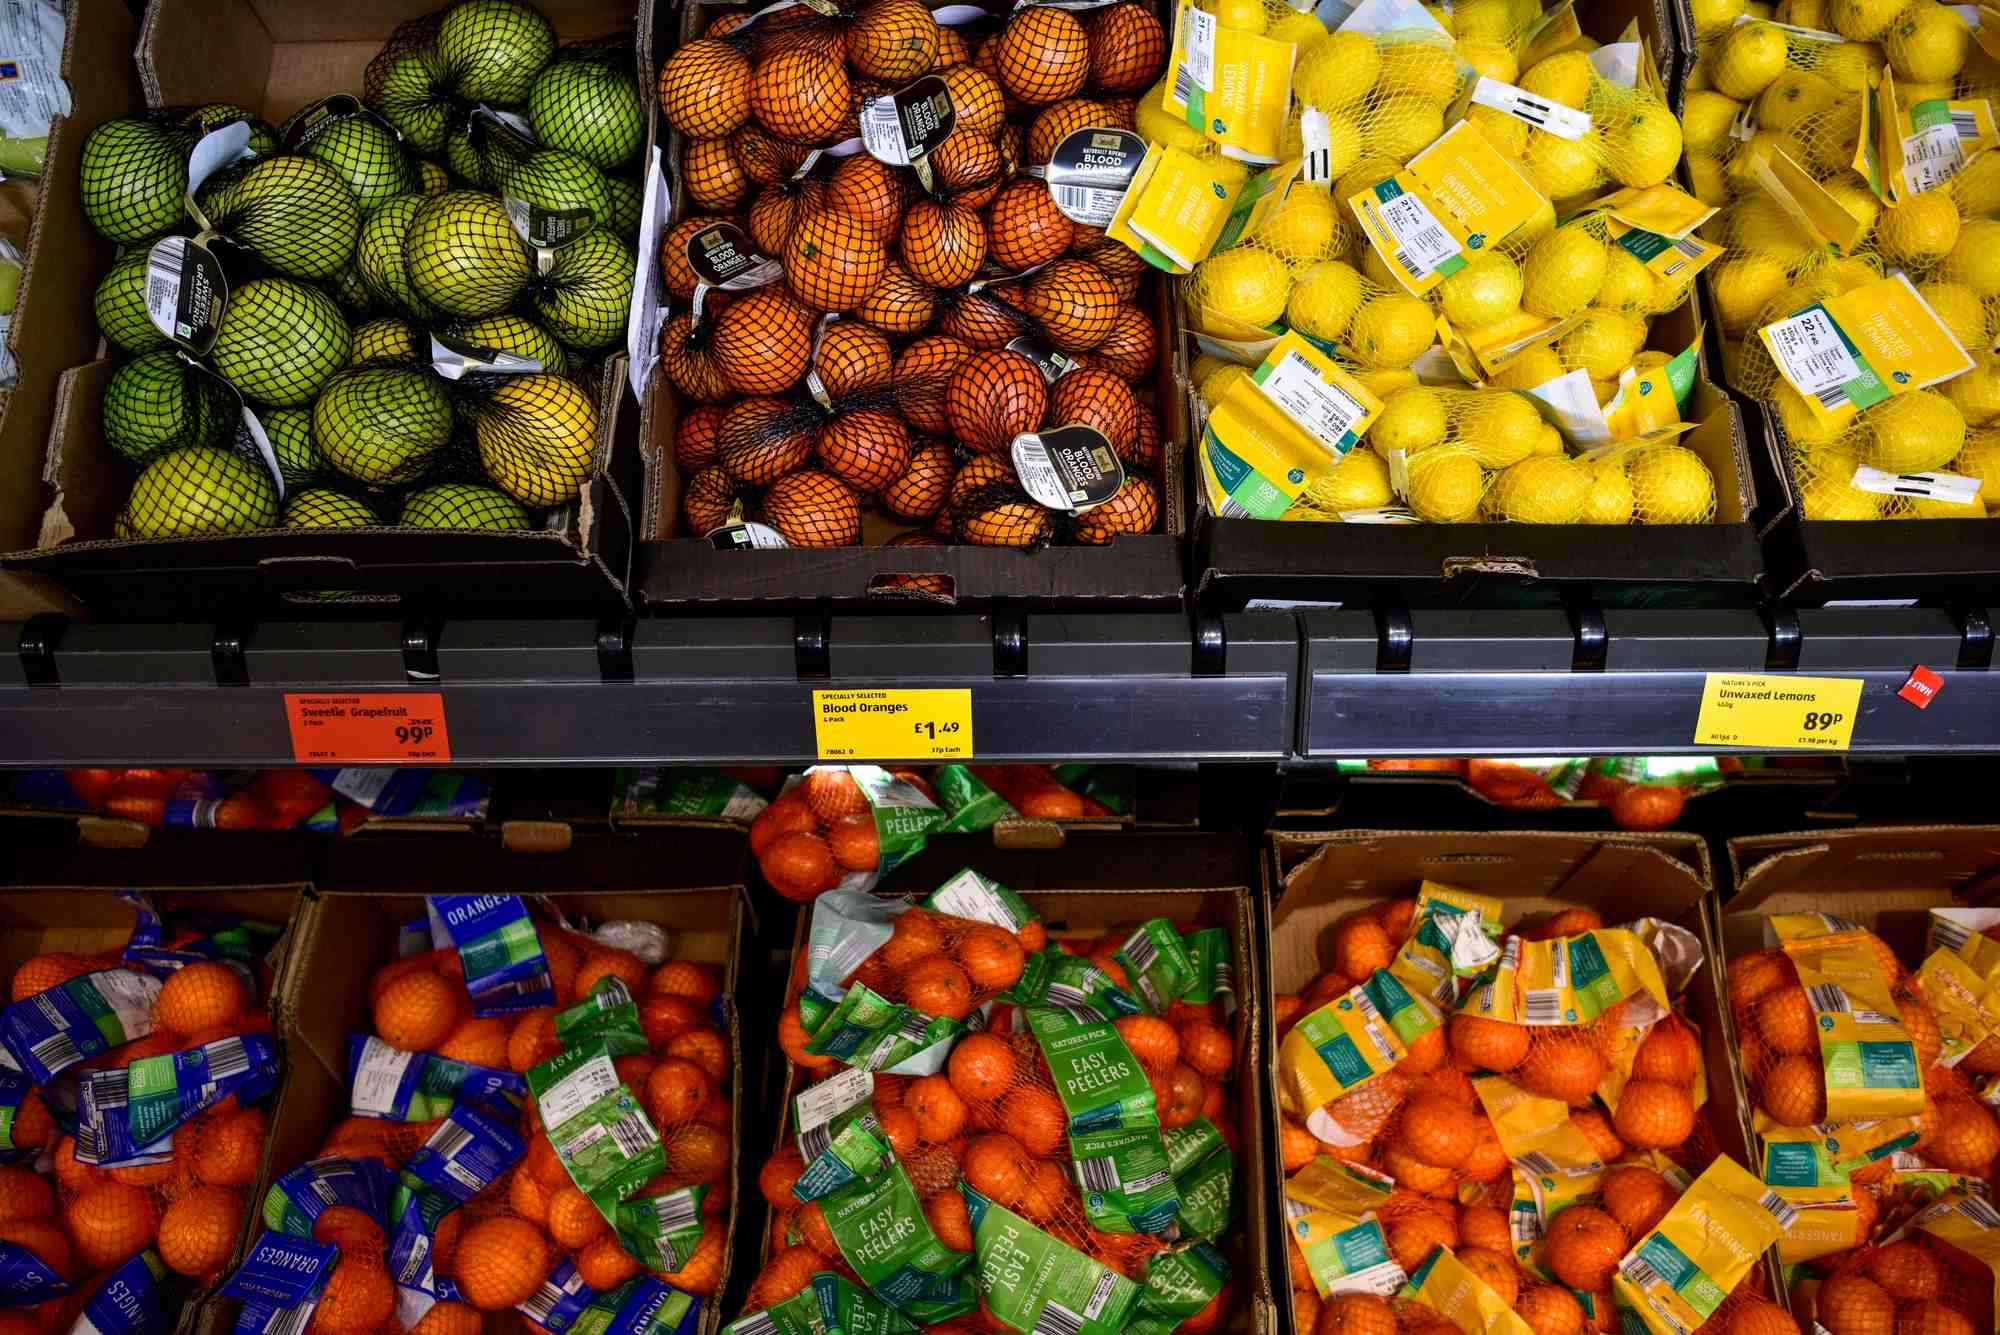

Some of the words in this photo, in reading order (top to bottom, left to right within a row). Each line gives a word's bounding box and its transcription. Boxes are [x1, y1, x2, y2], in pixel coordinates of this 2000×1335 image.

[911, 102, 928, 141] ORANGES
[920, 100, 934, 130] BLOOD
[1084, 154, 1122, 166] BLOOD
[710, 248, 735, 265] BLOOD
[191, 263, 205, 334] GRAPEFRUIT
[198, 277, 210, 328] SWEETIE
[1801, 318, 1815, 333] 22
[1062, 448, 1089, 488] ORANGES
[1074, 450, 1095, 480] BLOOD
[823, 703, 857, 713] Blood
[859, 702, 909, 714] Oranges
[1719, 689, 1771, 701] Unwaxed
[1773, 690, 1816, 702] Lemons
[301, 706, 346, 717] Sweetie
[350, 706, 409, 718] Grapefruit
[1803, 712, 1843, 731] 89p
[394, 725, 433, 744] 99p
[914, 721, 960, 740] £1.49
[1050, 1033, 1089, 1050] NATURE'S
[1088, 1029, 1108, 1041] PICK
[1071, 1051, 1109, 1074] EASY
[1066, 1062, 1131, 1097] PEELERS
[838, 1192, 877, 1218] NATURE'S
[858, 1205, 896, 1240] EASY
[855, 1216, 917, 1265] PEELERS
[256, 1246, 320, 1275] ORANGES
[982, 1225, 1020, 1295] PEELERS
[1000, 1249, 1030, 1293] EASY
[1035, 1254, 1057, 1296] NATURE'S
[1152, 1274, 1182, 1303] EAS
[1161, 1257, 1202, 1298] PEELE
[107, 1280, 148, 1328] ANGES
[852, 1293, 866, 1335] PEEL
[1023, 1295, 1037, 1317] PICK
